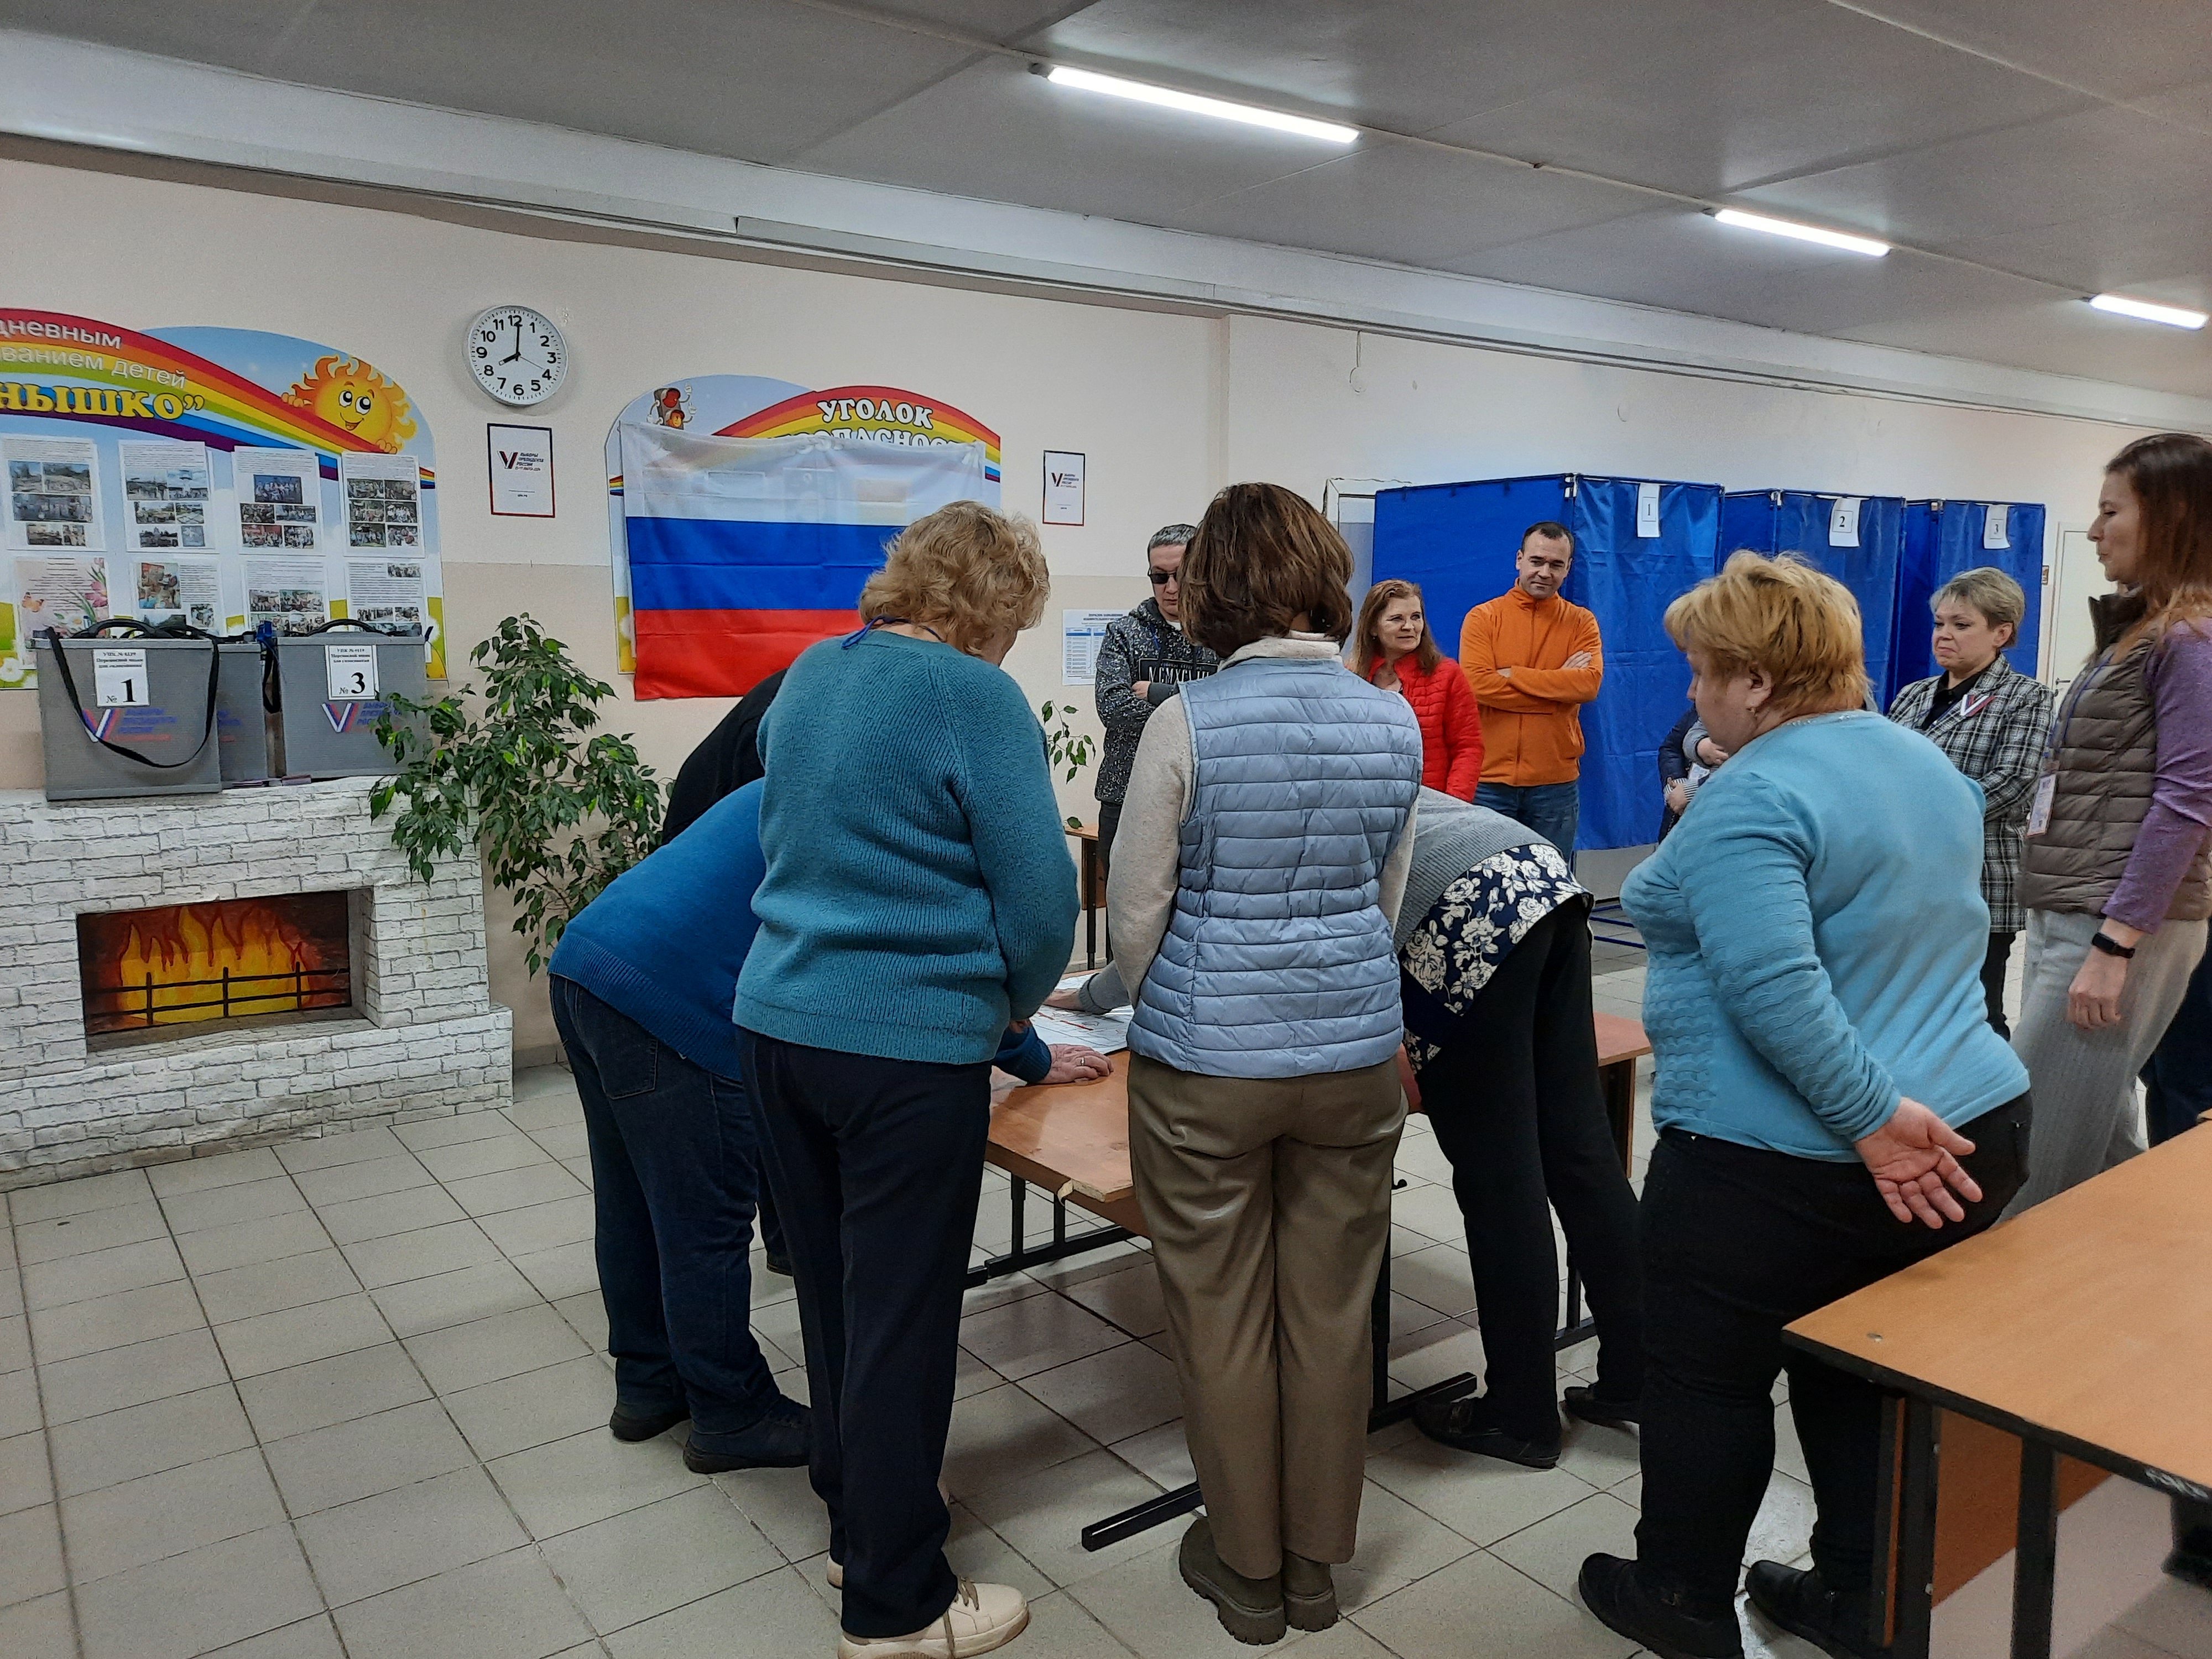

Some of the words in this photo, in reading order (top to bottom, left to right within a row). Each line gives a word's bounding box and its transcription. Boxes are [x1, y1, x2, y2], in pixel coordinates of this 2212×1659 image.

[493, 319, 504, 331] 11
[508, 315, 523, 327] 12
[529, 322, 535, 333] 1
[481, 330, 495, 342] 10
[540, 335, 550, 347] 2
[476, 347, 487, 358] 9
[547, 352, 556, 363] 3
[111, 360, 186, 389] детей
[484, 365, 494, 376] 8
[542, 369, 552, 380] 4
[497, 377, 507, 389] 7
[531, 380, 541, 392] 5
[513, 384, 524, 396] 6
[817, 398, 933, 429] УГОЛОК
[1647, 503, 1651, 516] 1
[1839, 515, 1845, 528] 2
[351, 672, 365, 693] 3
[121, 679, 137, 702] 1
